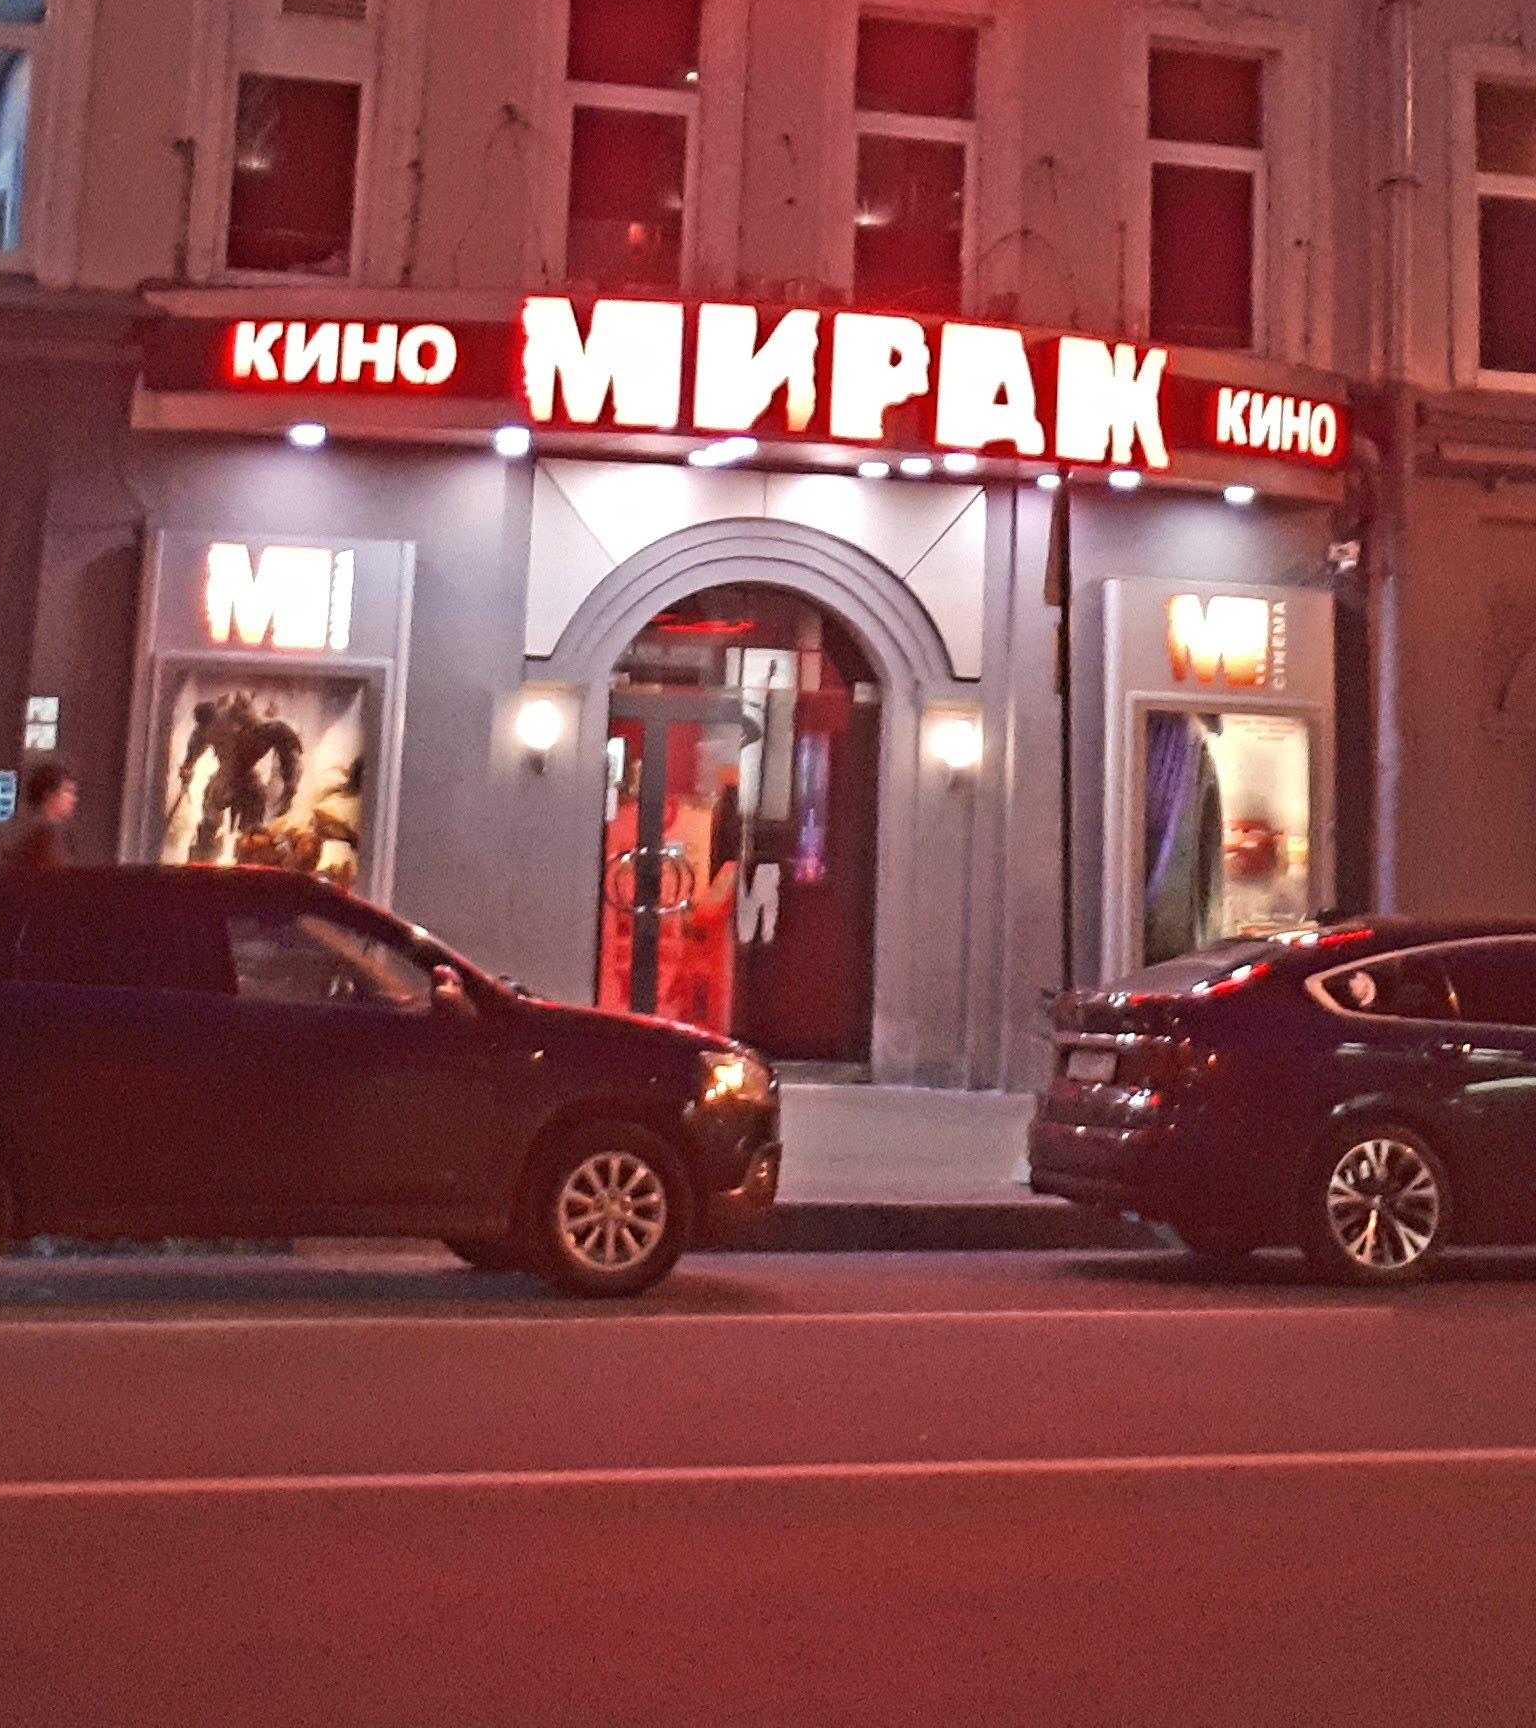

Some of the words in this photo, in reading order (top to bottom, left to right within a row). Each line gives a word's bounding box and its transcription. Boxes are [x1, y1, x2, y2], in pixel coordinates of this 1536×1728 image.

[232, 321, 457, 385] КИНО
[521, 295, 1170, 469] МИРАЖ
[1216, 386, 1339, 458] КИНО
[1271, 601, 1287, 691] CINEMA
